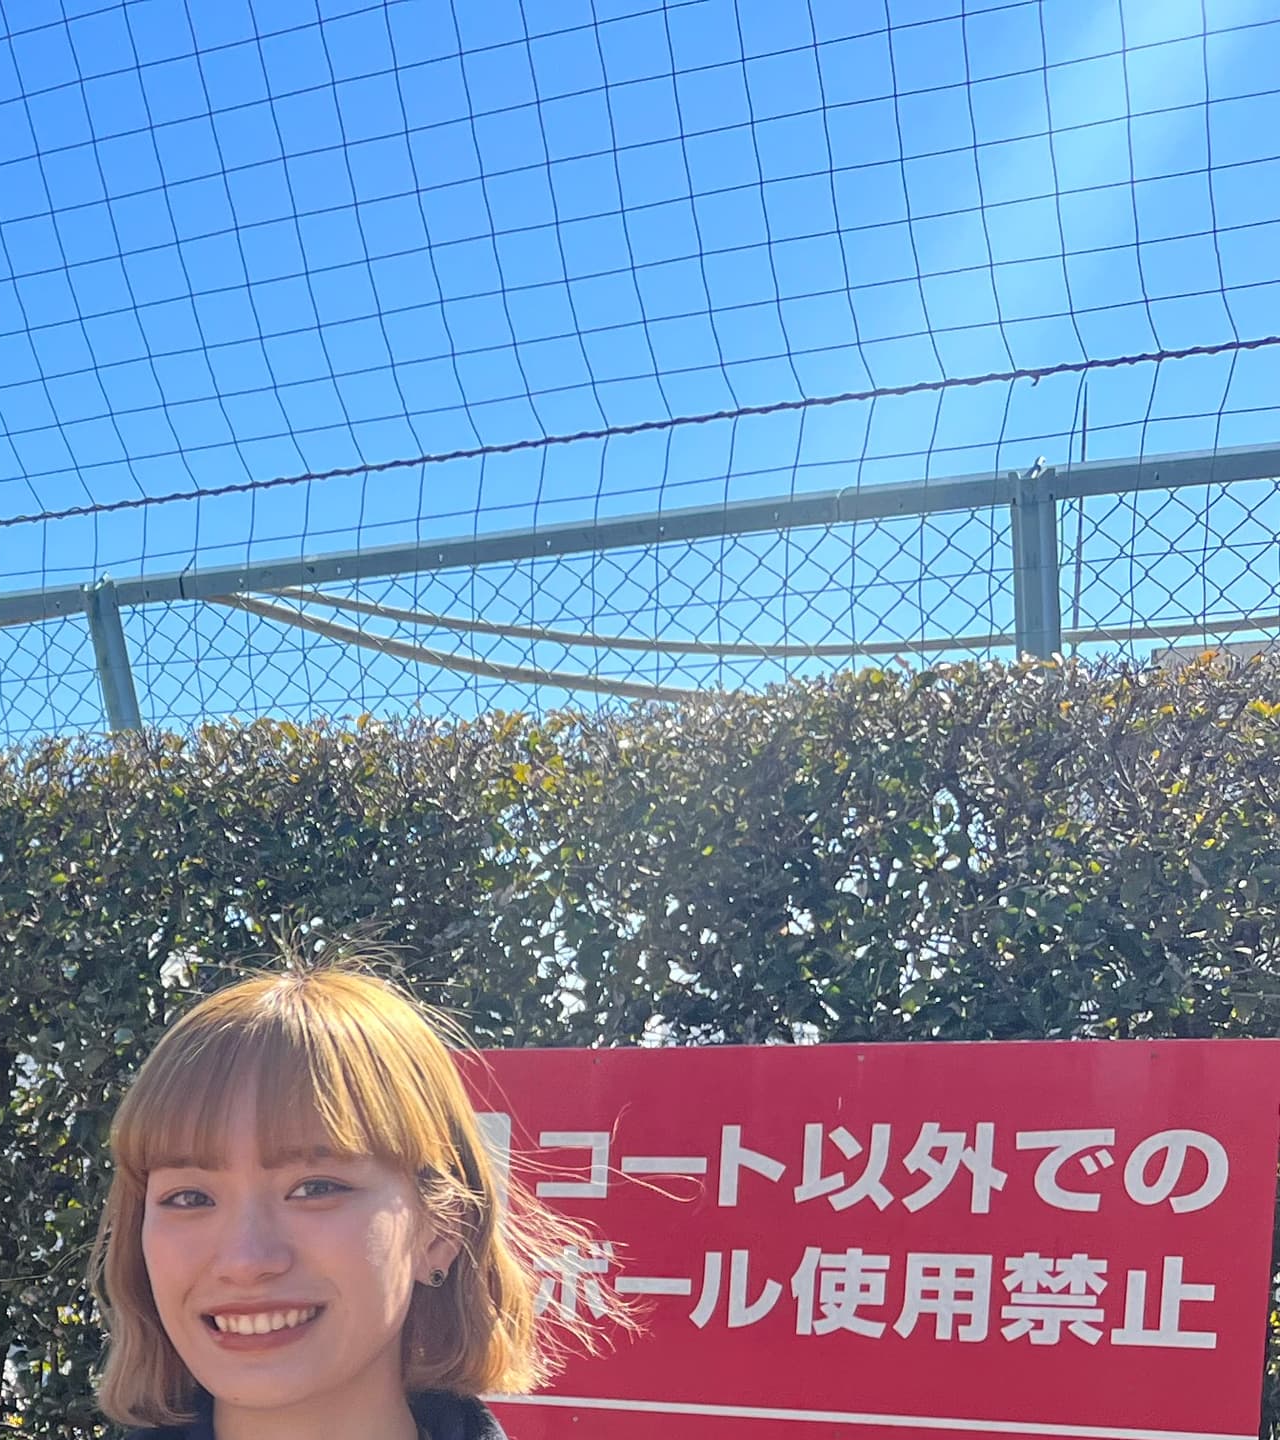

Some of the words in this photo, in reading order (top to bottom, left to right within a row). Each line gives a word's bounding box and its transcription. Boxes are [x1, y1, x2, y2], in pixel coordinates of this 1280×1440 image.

[536, 1121, 1230, 1215] コート以外での
[533, 1240, 1218, 1350] ボール使用禁止
